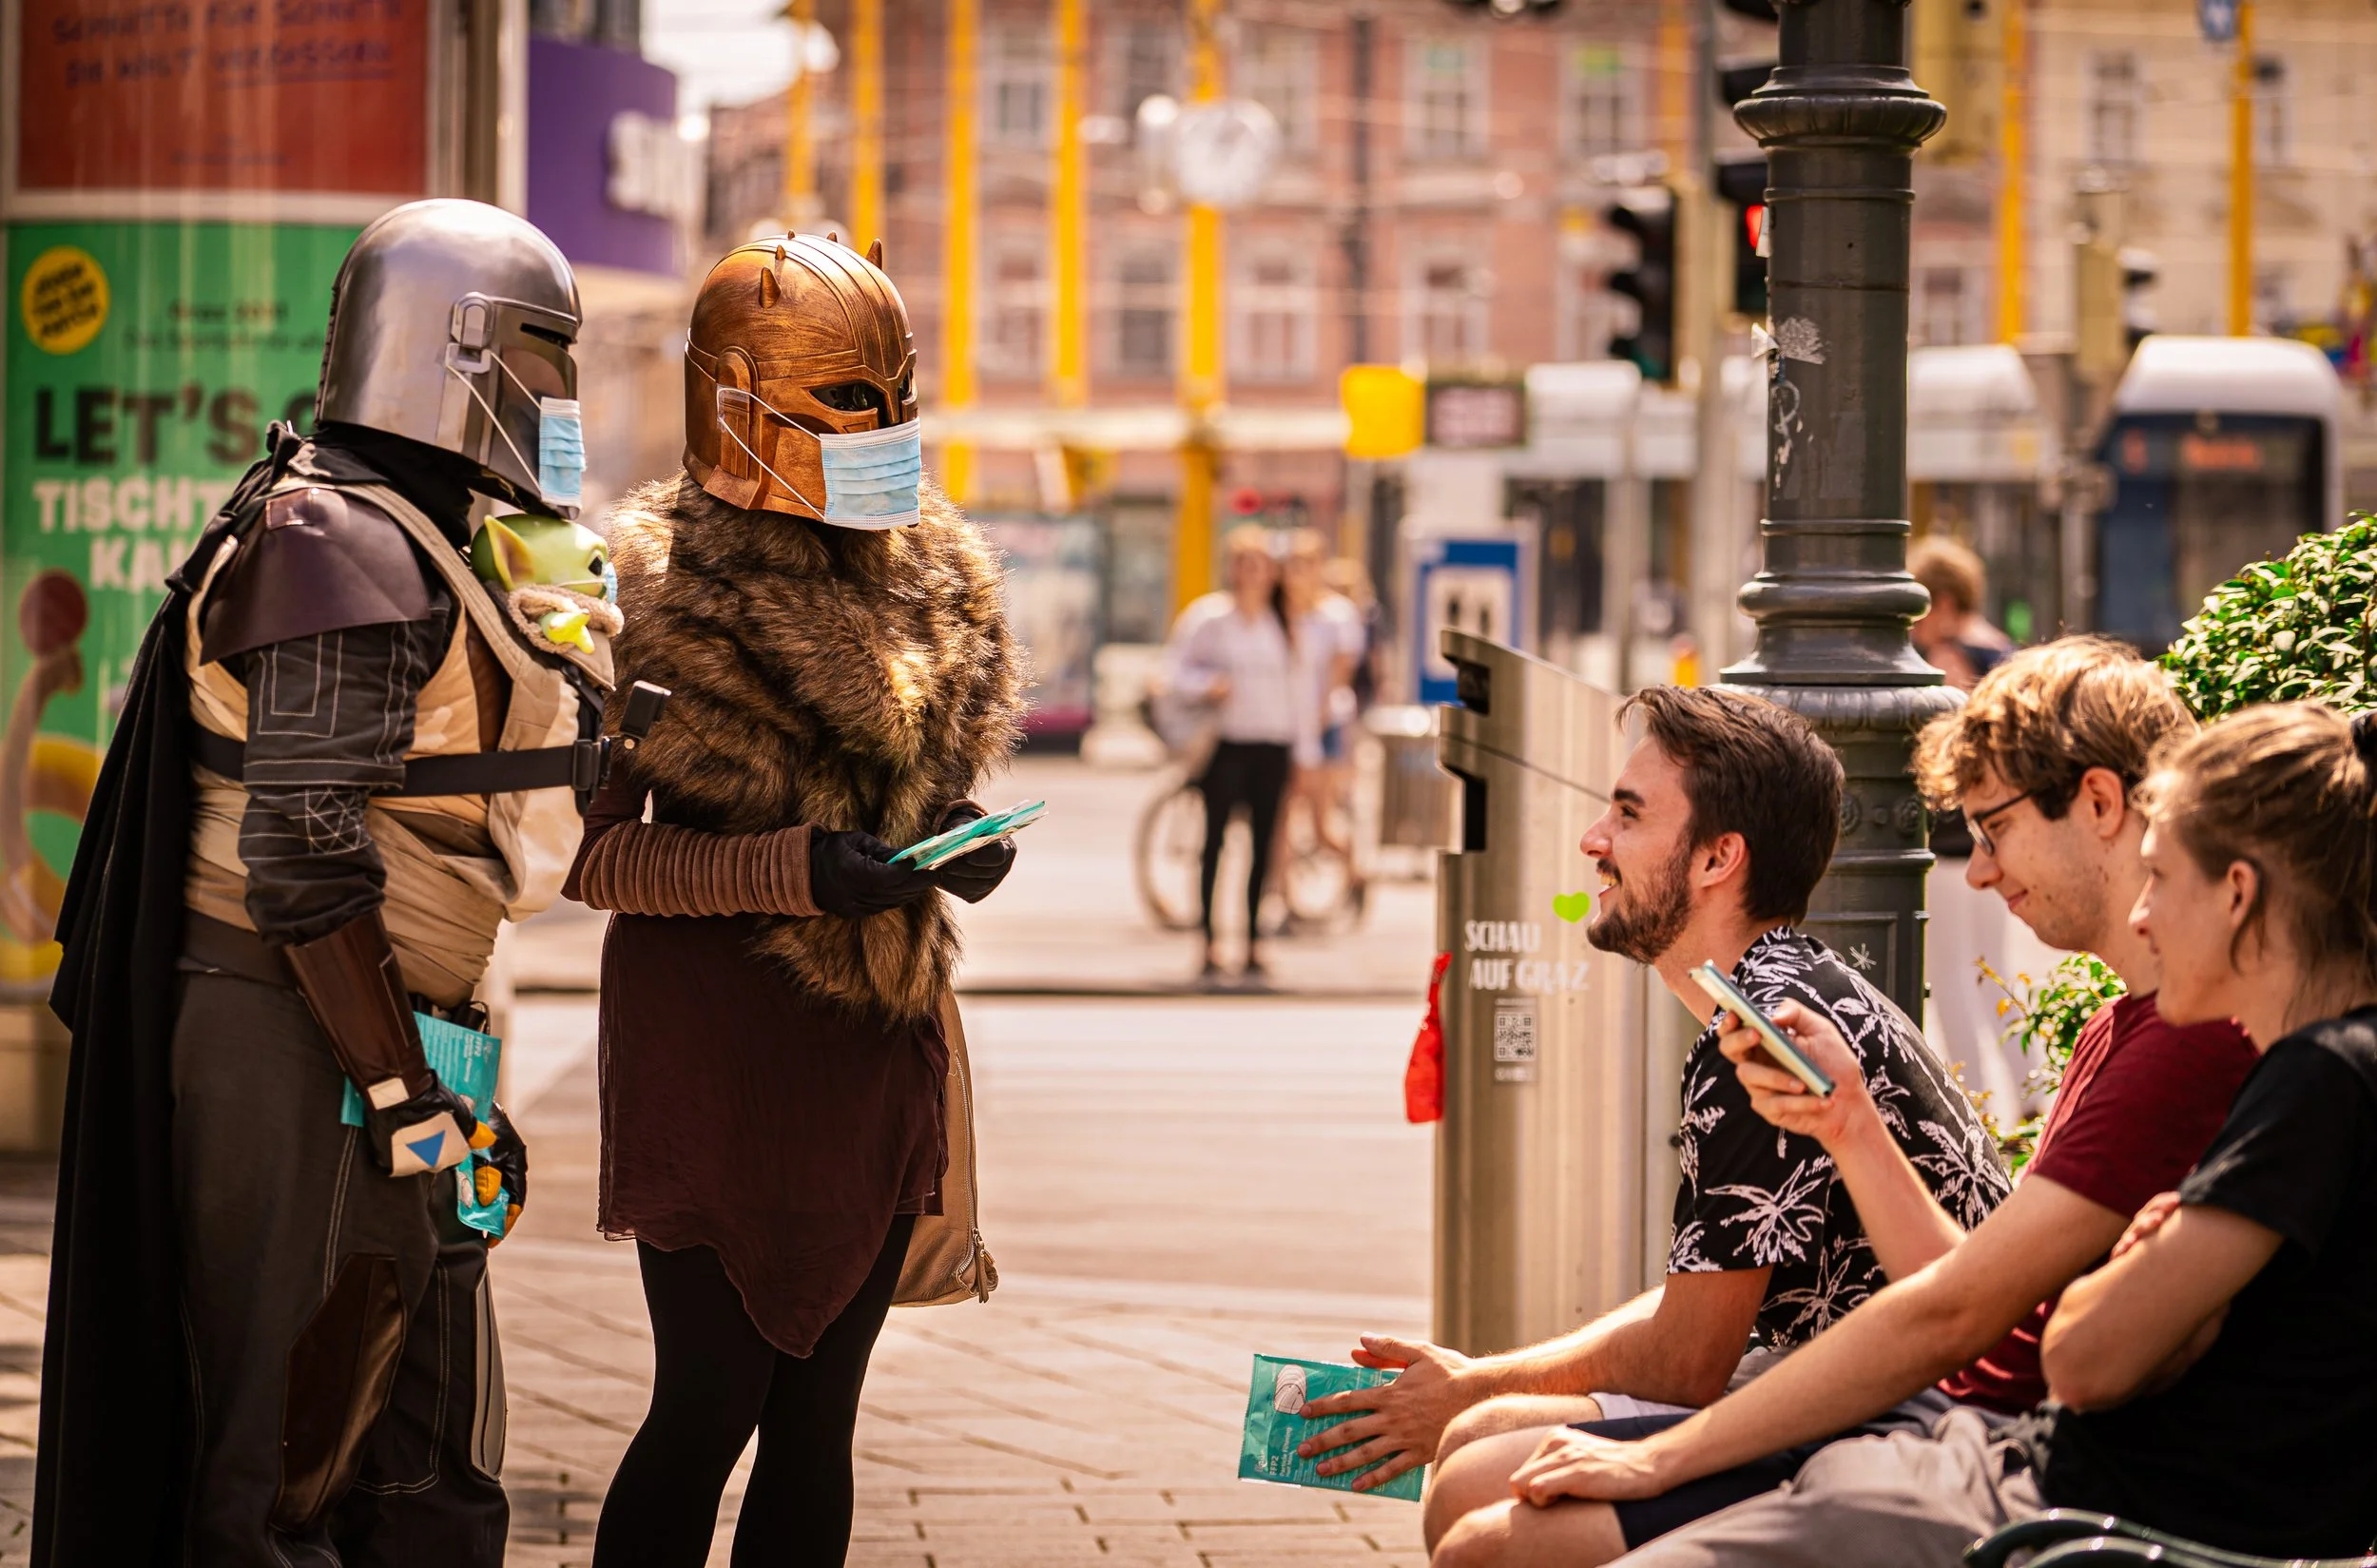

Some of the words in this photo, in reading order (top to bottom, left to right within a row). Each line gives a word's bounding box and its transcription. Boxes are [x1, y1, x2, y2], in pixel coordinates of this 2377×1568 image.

[1464, 920, 1541, 952] SCHAU
[1469, 958, 1514, 990] AUF
[1515, 959, 1591, 993] GRAZ
[1269, 1455, 1280, 1476] FFP2
